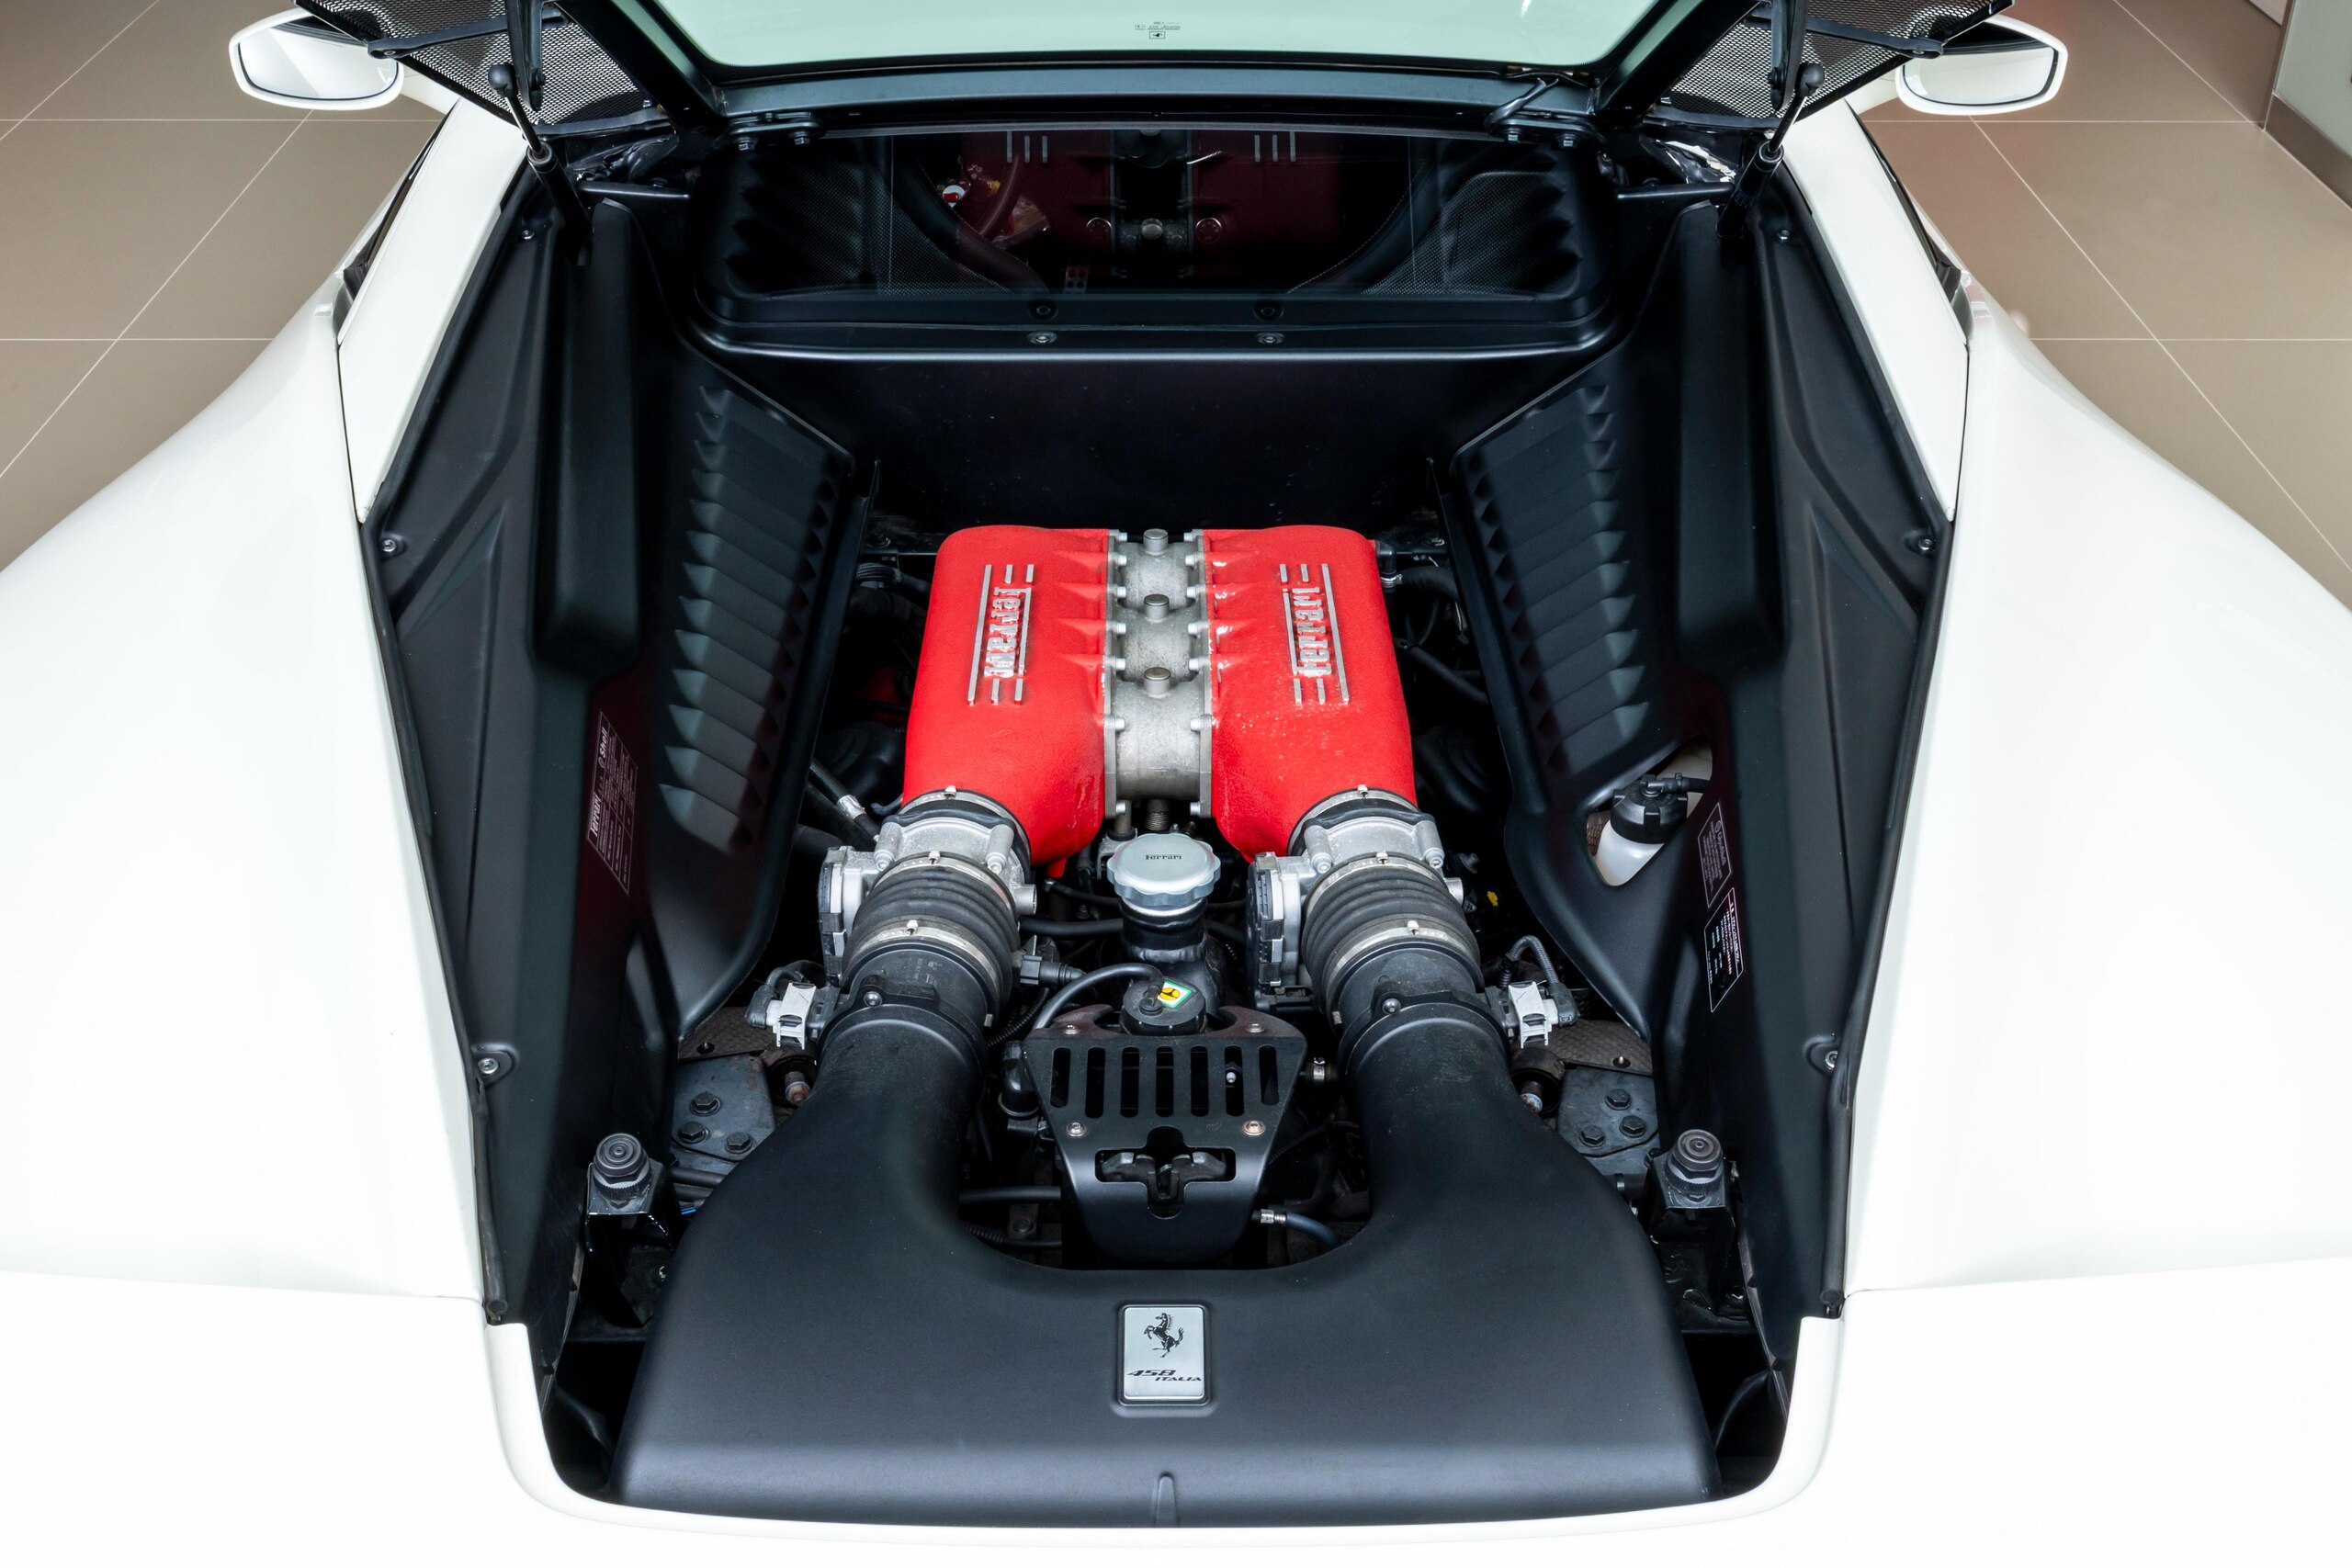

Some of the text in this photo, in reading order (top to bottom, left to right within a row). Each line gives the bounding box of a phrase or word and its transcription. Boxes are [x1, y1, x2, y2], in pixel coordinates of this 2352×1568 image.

[984, 587, 1032, 679] Ferrari
[1283, 587, 1332, 678] Ferrari
[599, 728, 608, 758] Shell
